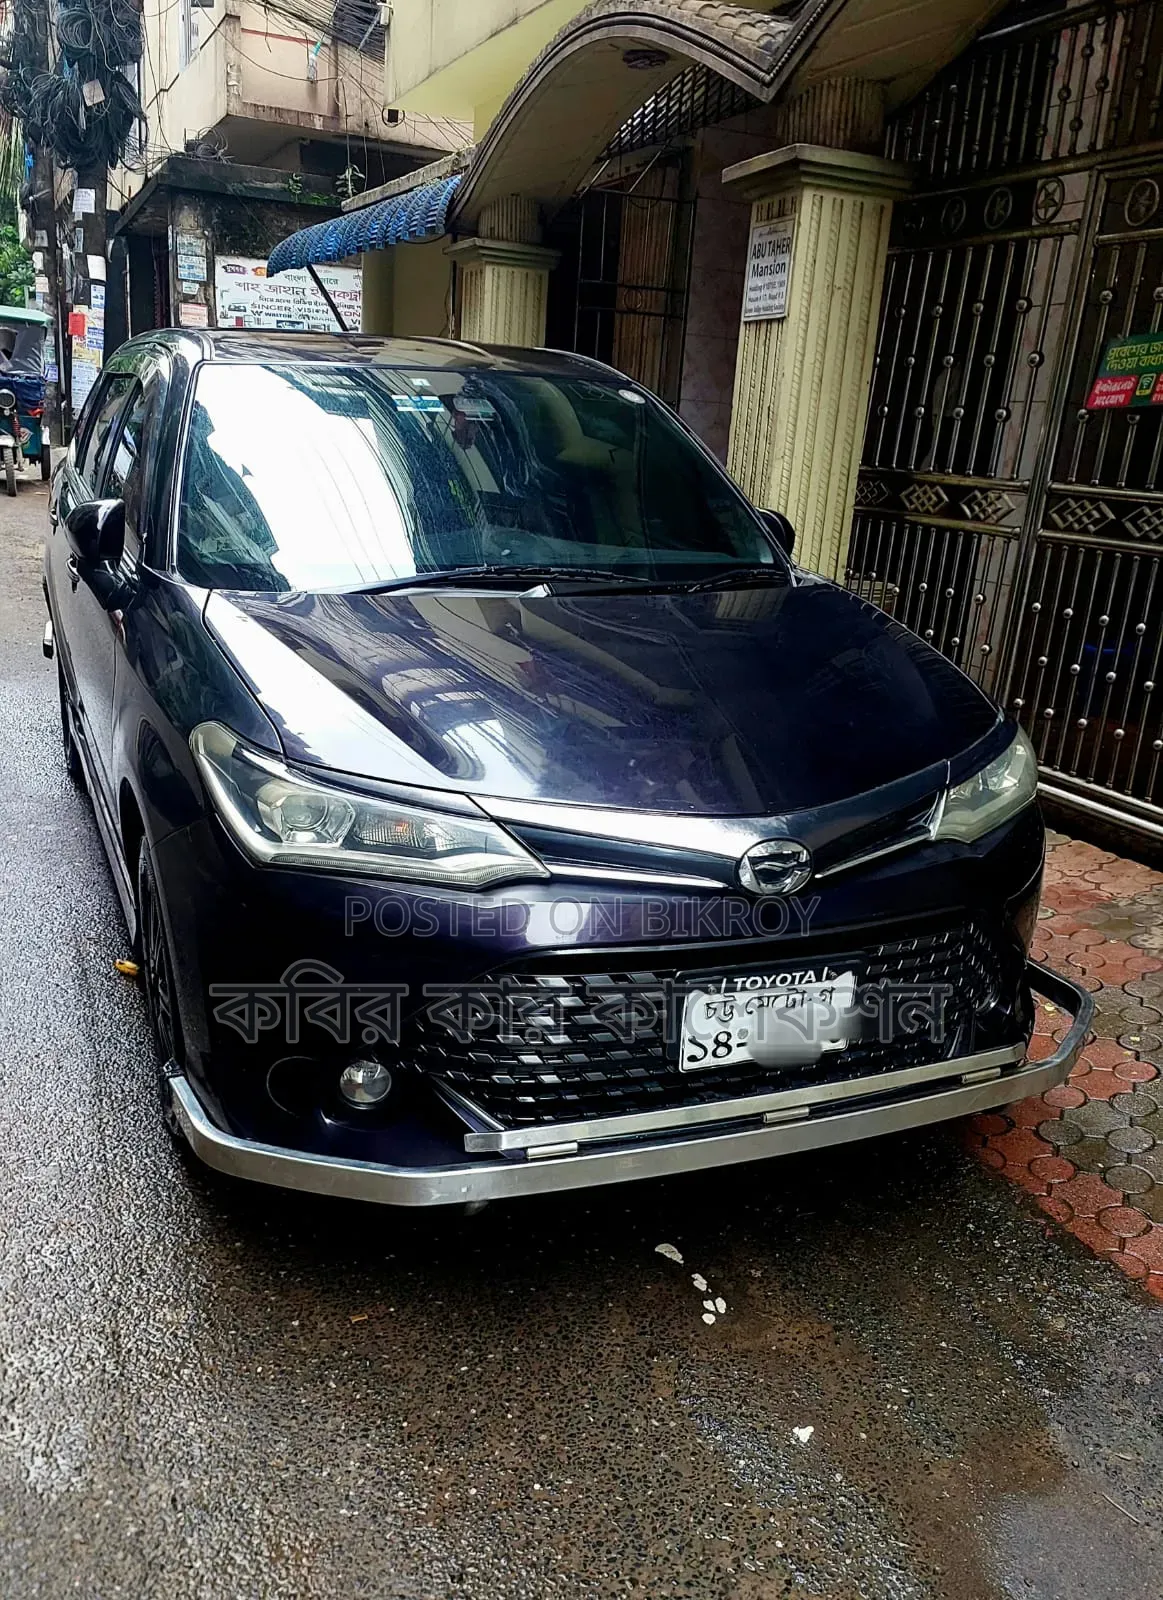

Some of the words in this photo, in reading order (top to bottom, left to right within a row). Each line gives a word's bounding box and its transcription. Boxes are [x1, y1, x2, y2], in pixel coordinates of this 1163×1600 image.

[752, 242, 767, 260] ABU
[768, 237, 791, 257] TAHER
[752, 260, 786, 278] Mansion
[251, 302, 292, 313] SINGER
[733, 969, 817, 991] TOYOTA
